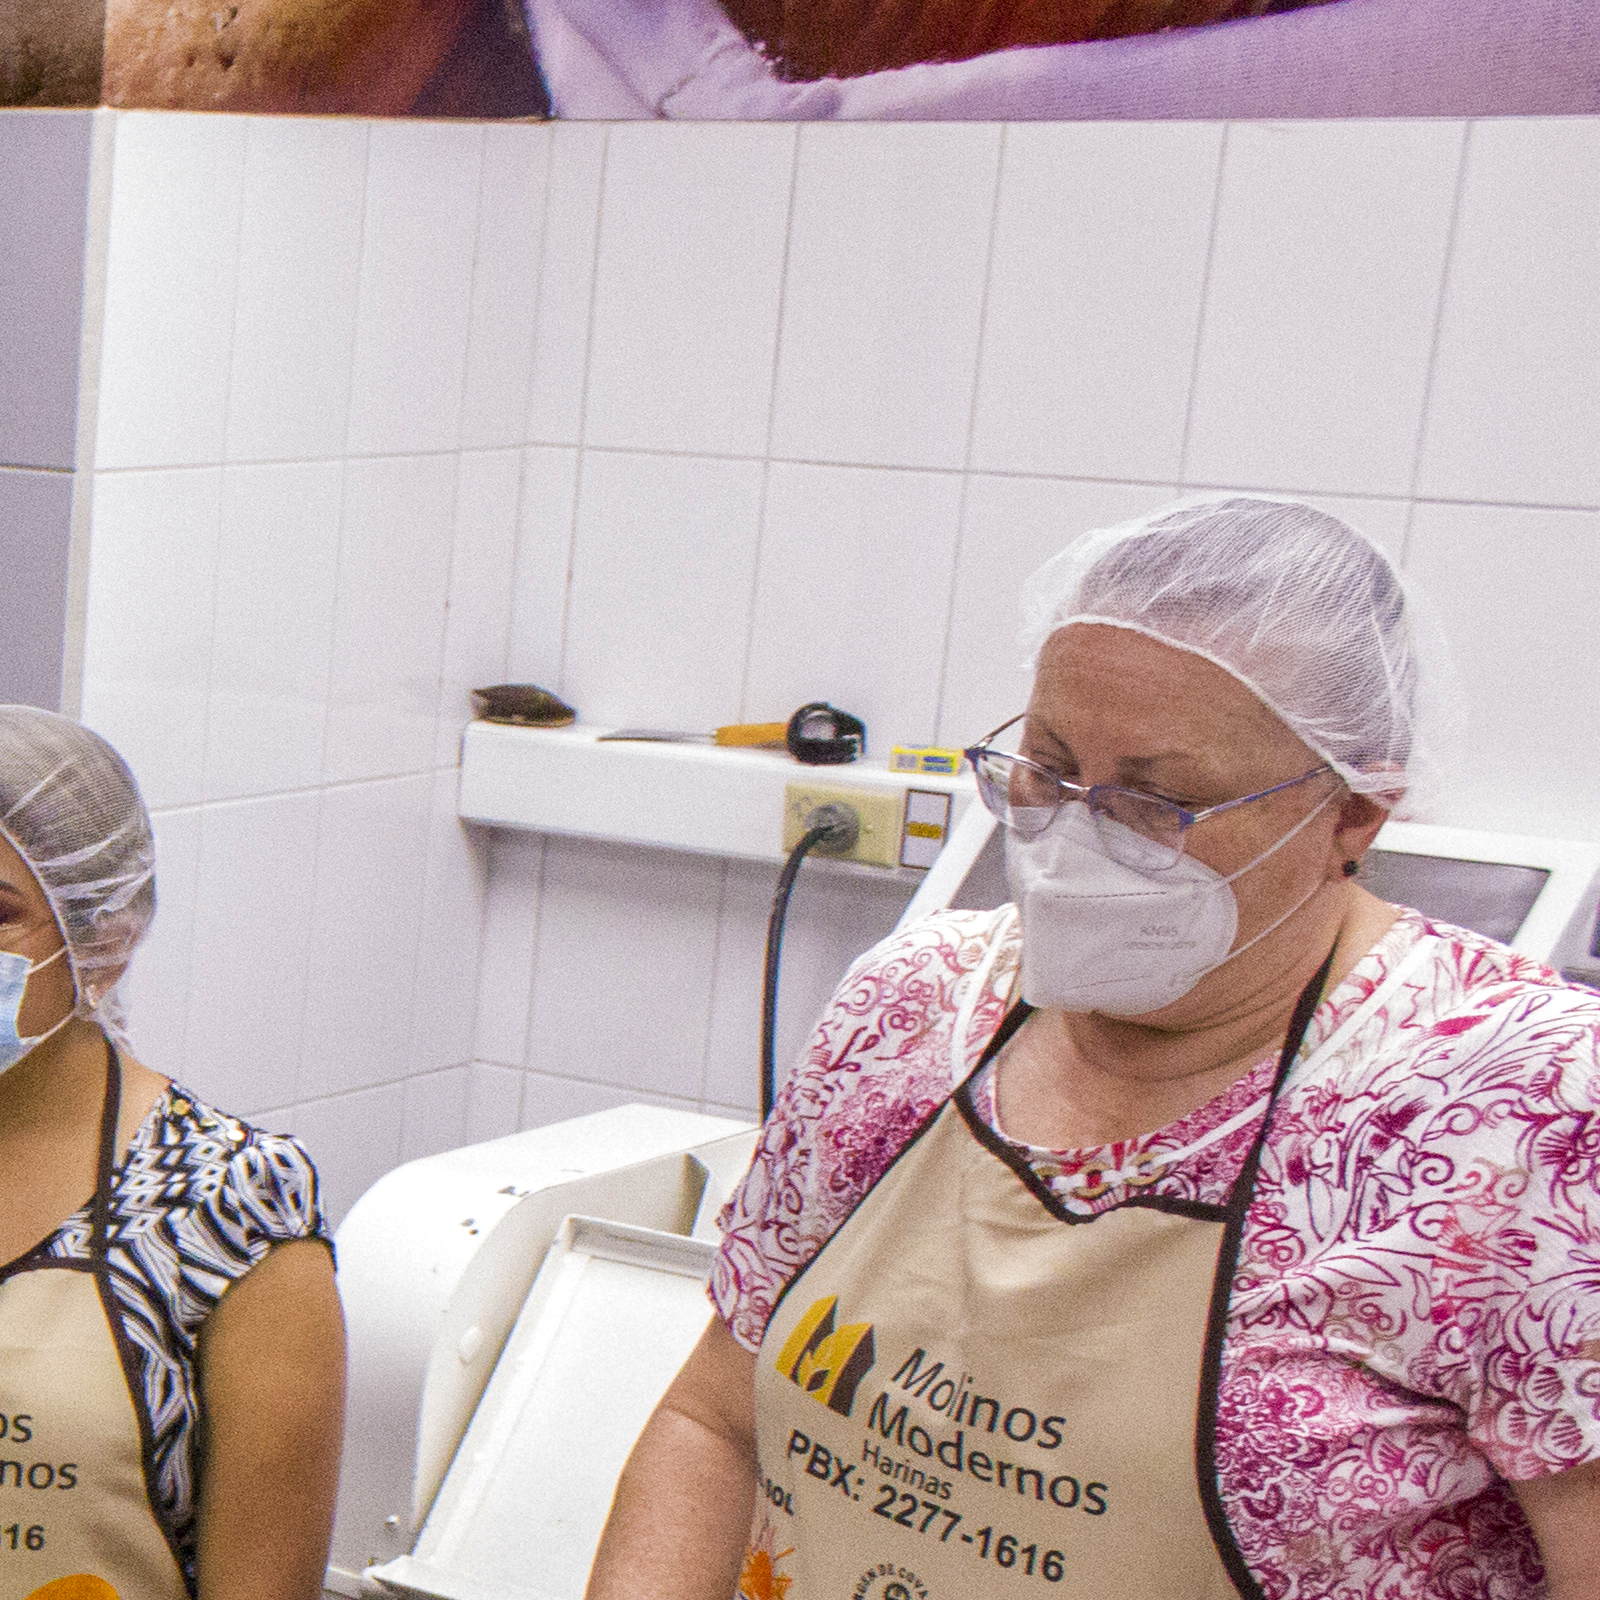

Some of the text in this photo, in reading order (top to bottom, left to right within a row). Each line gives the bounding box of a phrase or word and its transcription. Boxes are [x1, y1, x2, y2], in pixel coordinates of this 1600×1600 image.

[866, 1391, 1109, 1516] Modernos
[891, 1347, 1067, 1450] Molinos
[786, 1428, 1066, 1583] PBX: 2277-1616
[861, 1439, 954, 1500] Harinas
